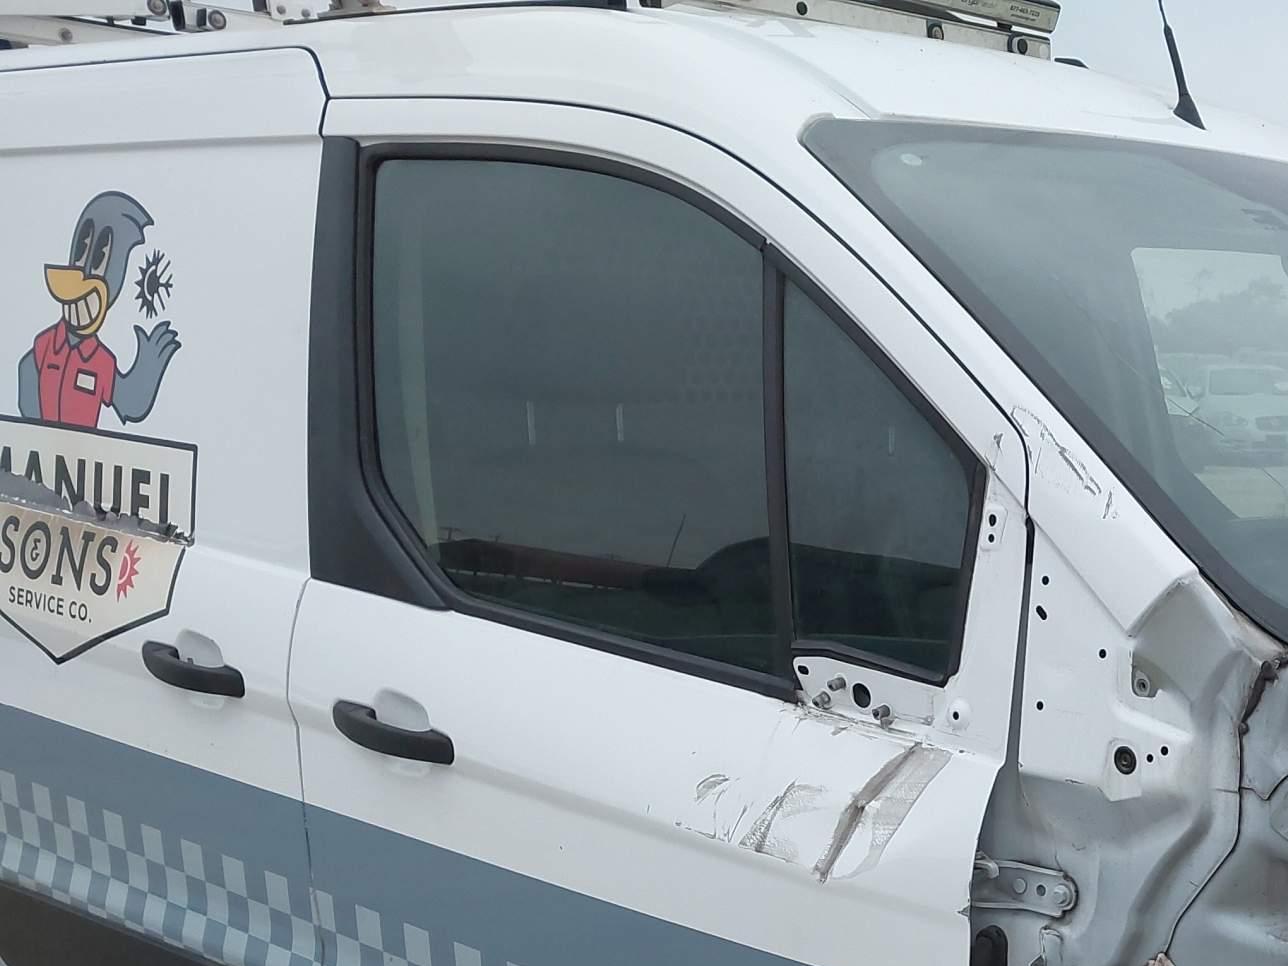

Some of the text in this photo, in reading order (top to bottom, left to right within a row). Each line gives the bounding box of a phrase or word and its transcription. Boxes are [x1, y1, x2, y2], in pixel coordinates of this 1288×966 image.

[0, 516, 118, 596] SONS
[8, 586, 92, 623] SERVICE CO.
